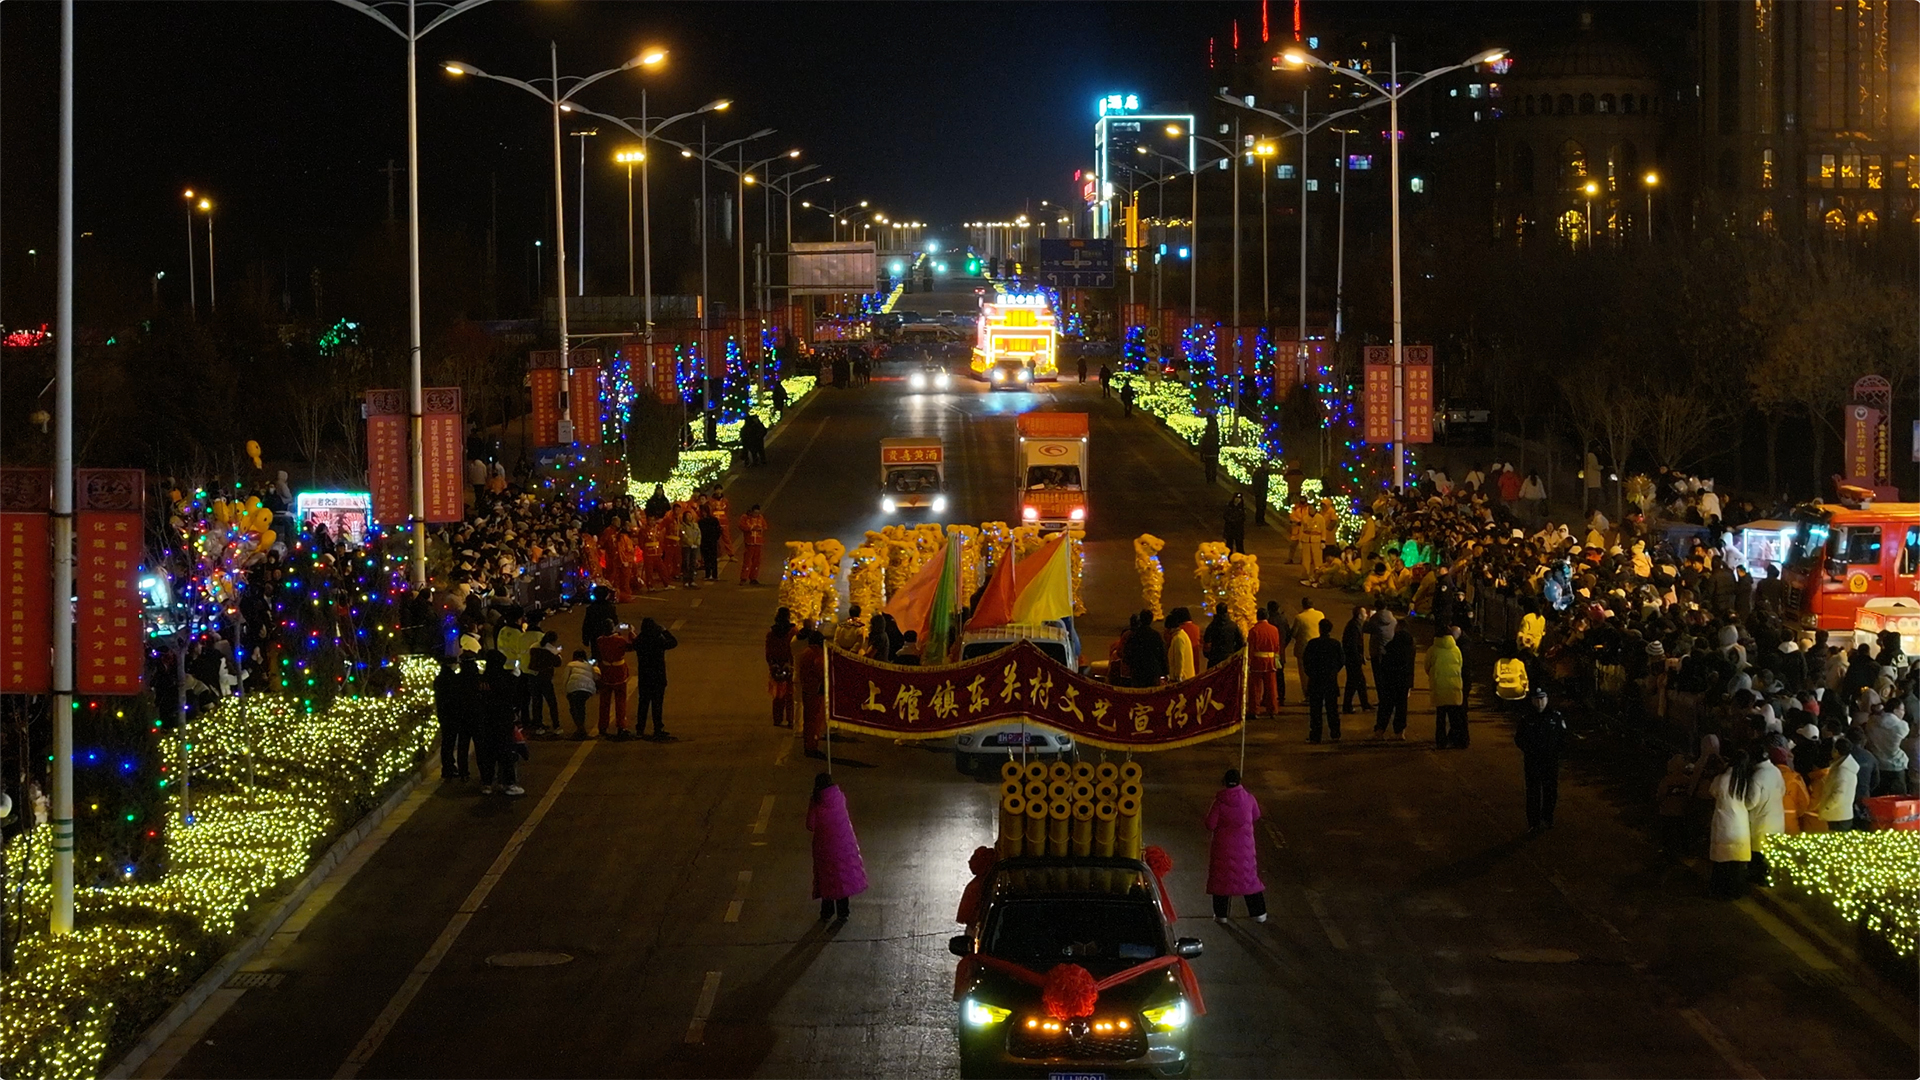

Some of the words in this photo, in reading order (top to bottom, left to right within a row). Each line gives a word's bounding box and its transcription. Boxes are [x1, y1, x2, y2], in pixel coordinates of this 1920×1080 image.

[1148, 329, 1158, 338] 40
[1370, 371, 1378, 437] 遵守社会公德
[1380, 371, 1388, 437] 强化卫生意识
[12, 522, 24, 684] 发展是党执政兴国的第一要务
[93, 522, 106, 684] 化现代化建设人才支撑
[114, 522, 127, 685] 实施科教兴国战略强
[860, 660, 1225, 735] 上馆镇东关村文艺宣传队
